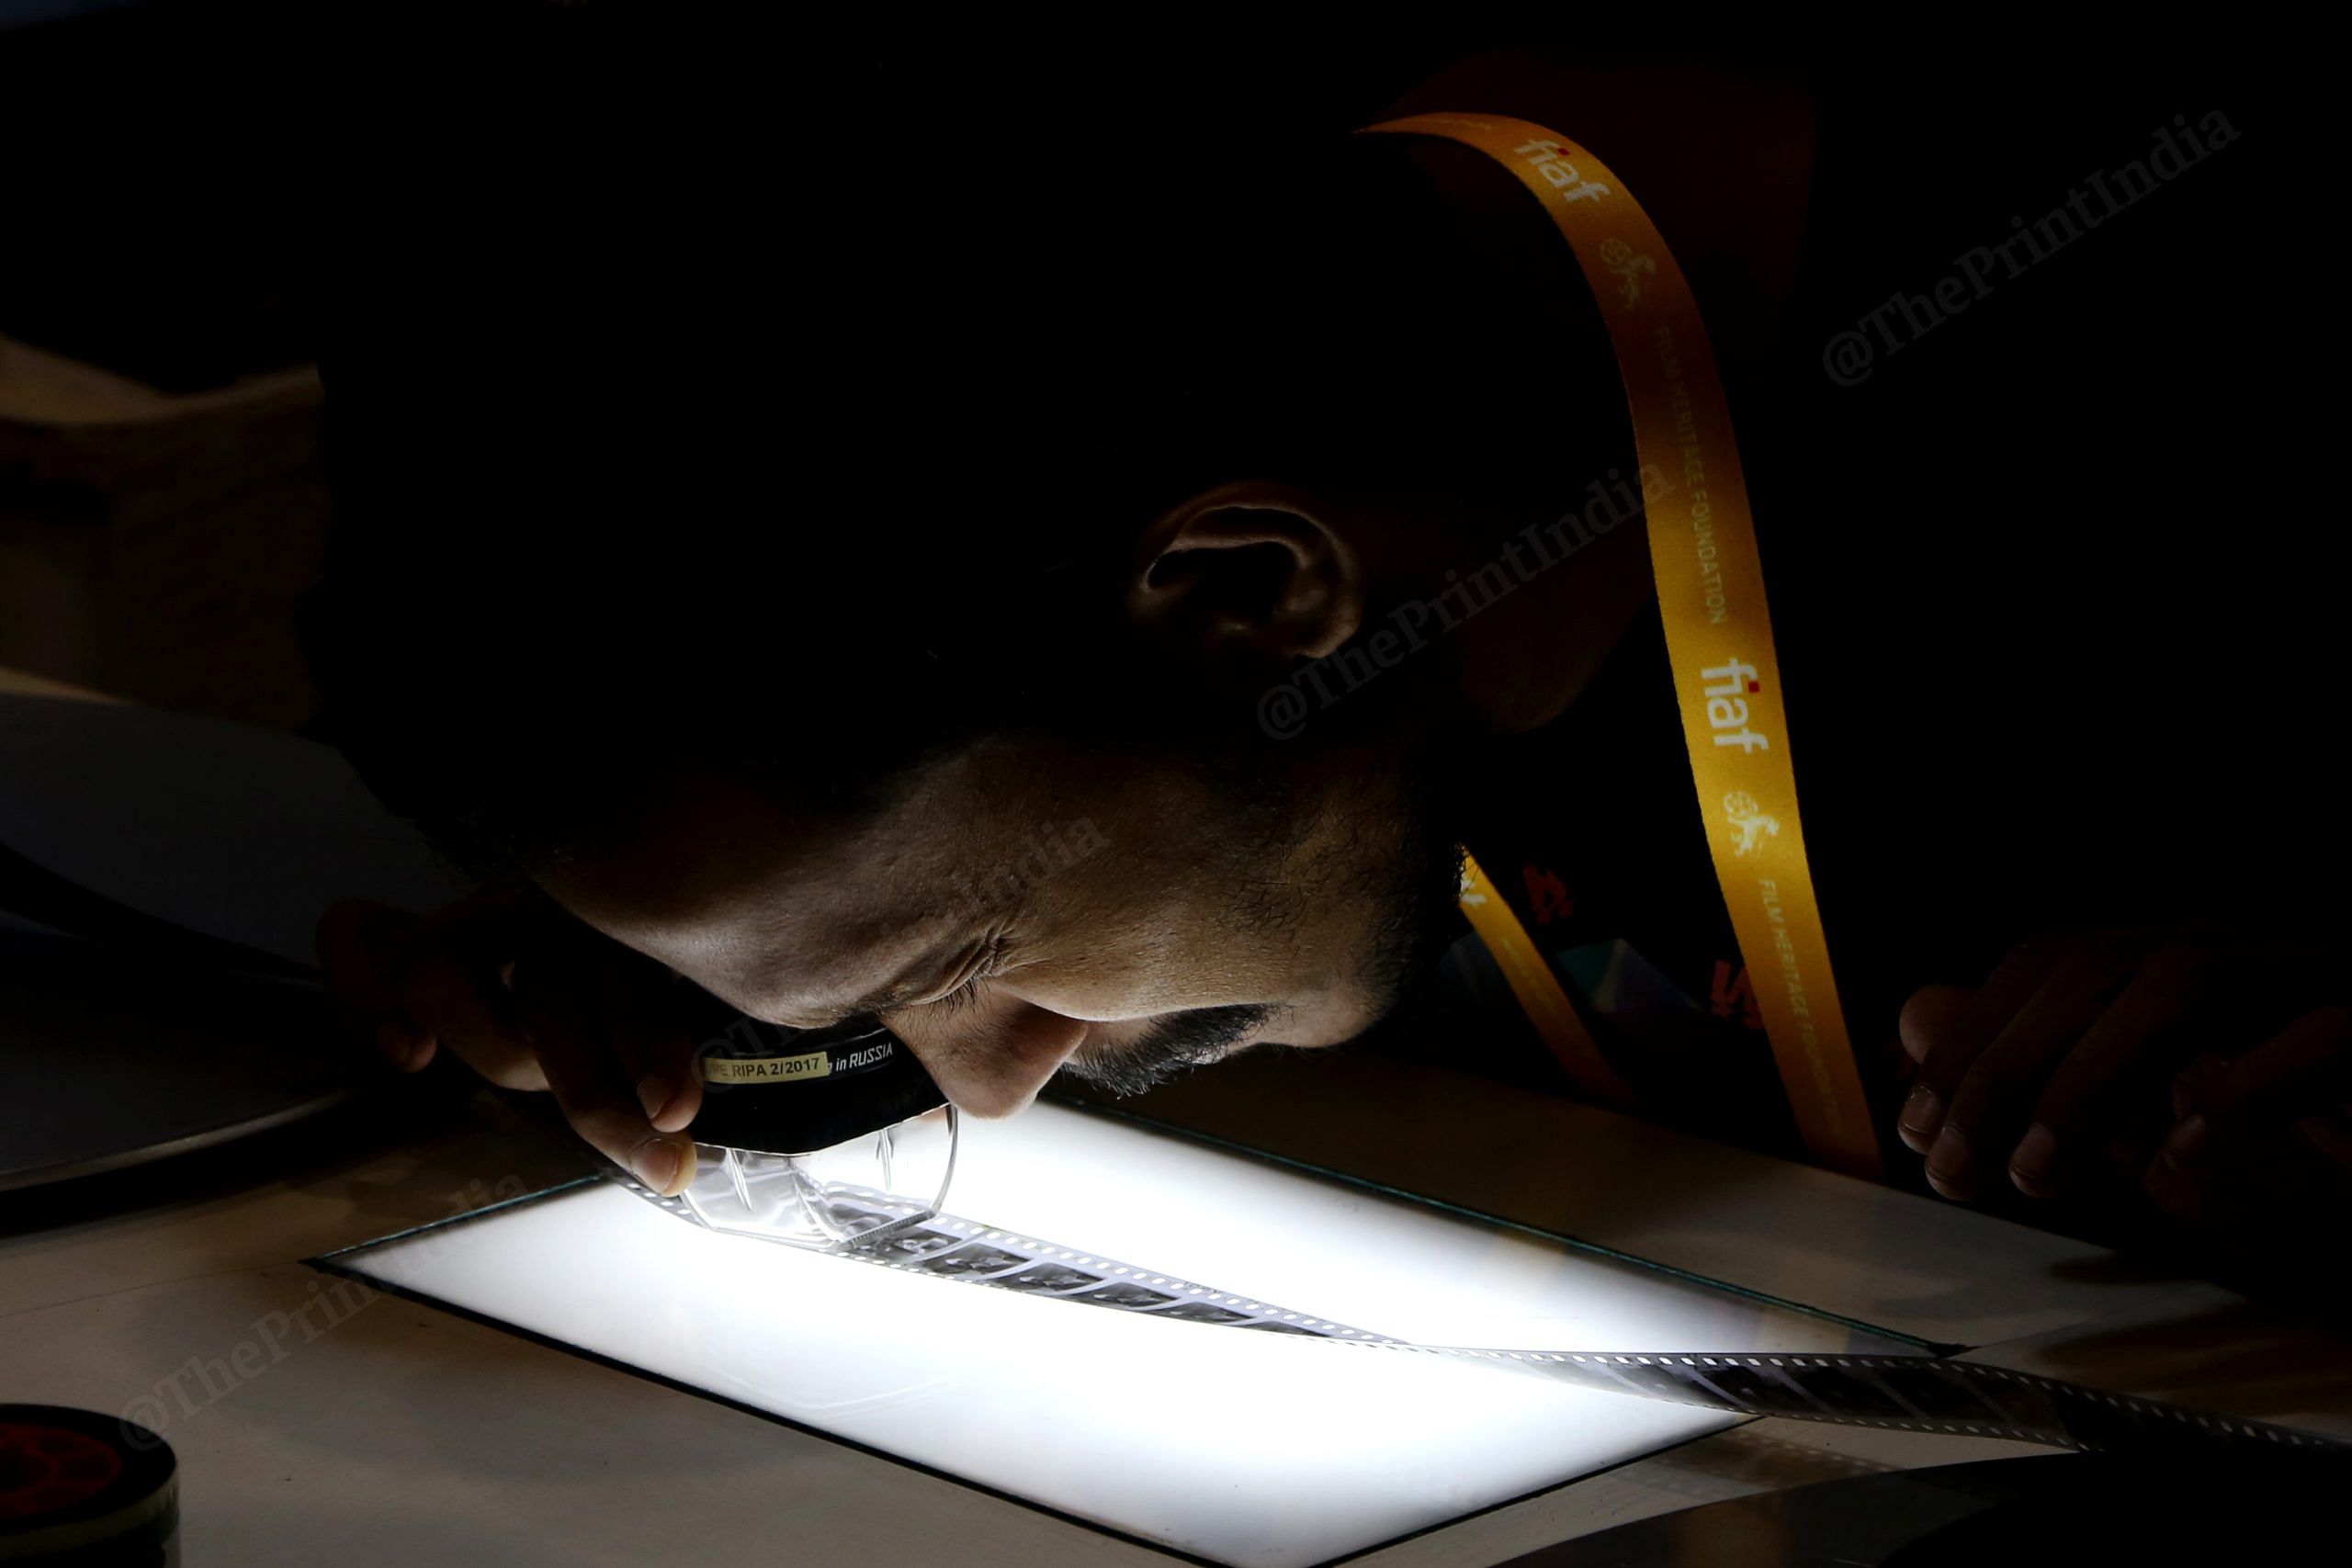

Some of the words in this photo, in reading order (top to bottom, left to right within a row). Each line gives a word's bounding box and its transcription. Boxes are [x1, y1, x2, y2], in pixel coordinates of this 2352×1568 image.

[1513, 139, 1611, 203] fiaf
[1690, 491, 1728, 625] FOUNDATION
[1701, 657, 1769, 754] fiaf
[1758, 878, 1785, 924] FILM
[732, 1064, 766, 1077] RIPA
[770, 1057, 820, 1075] 2/2017
[835, 1057, 847, 1072] in
[849, 1042, 893, 1069] RUSSIA
